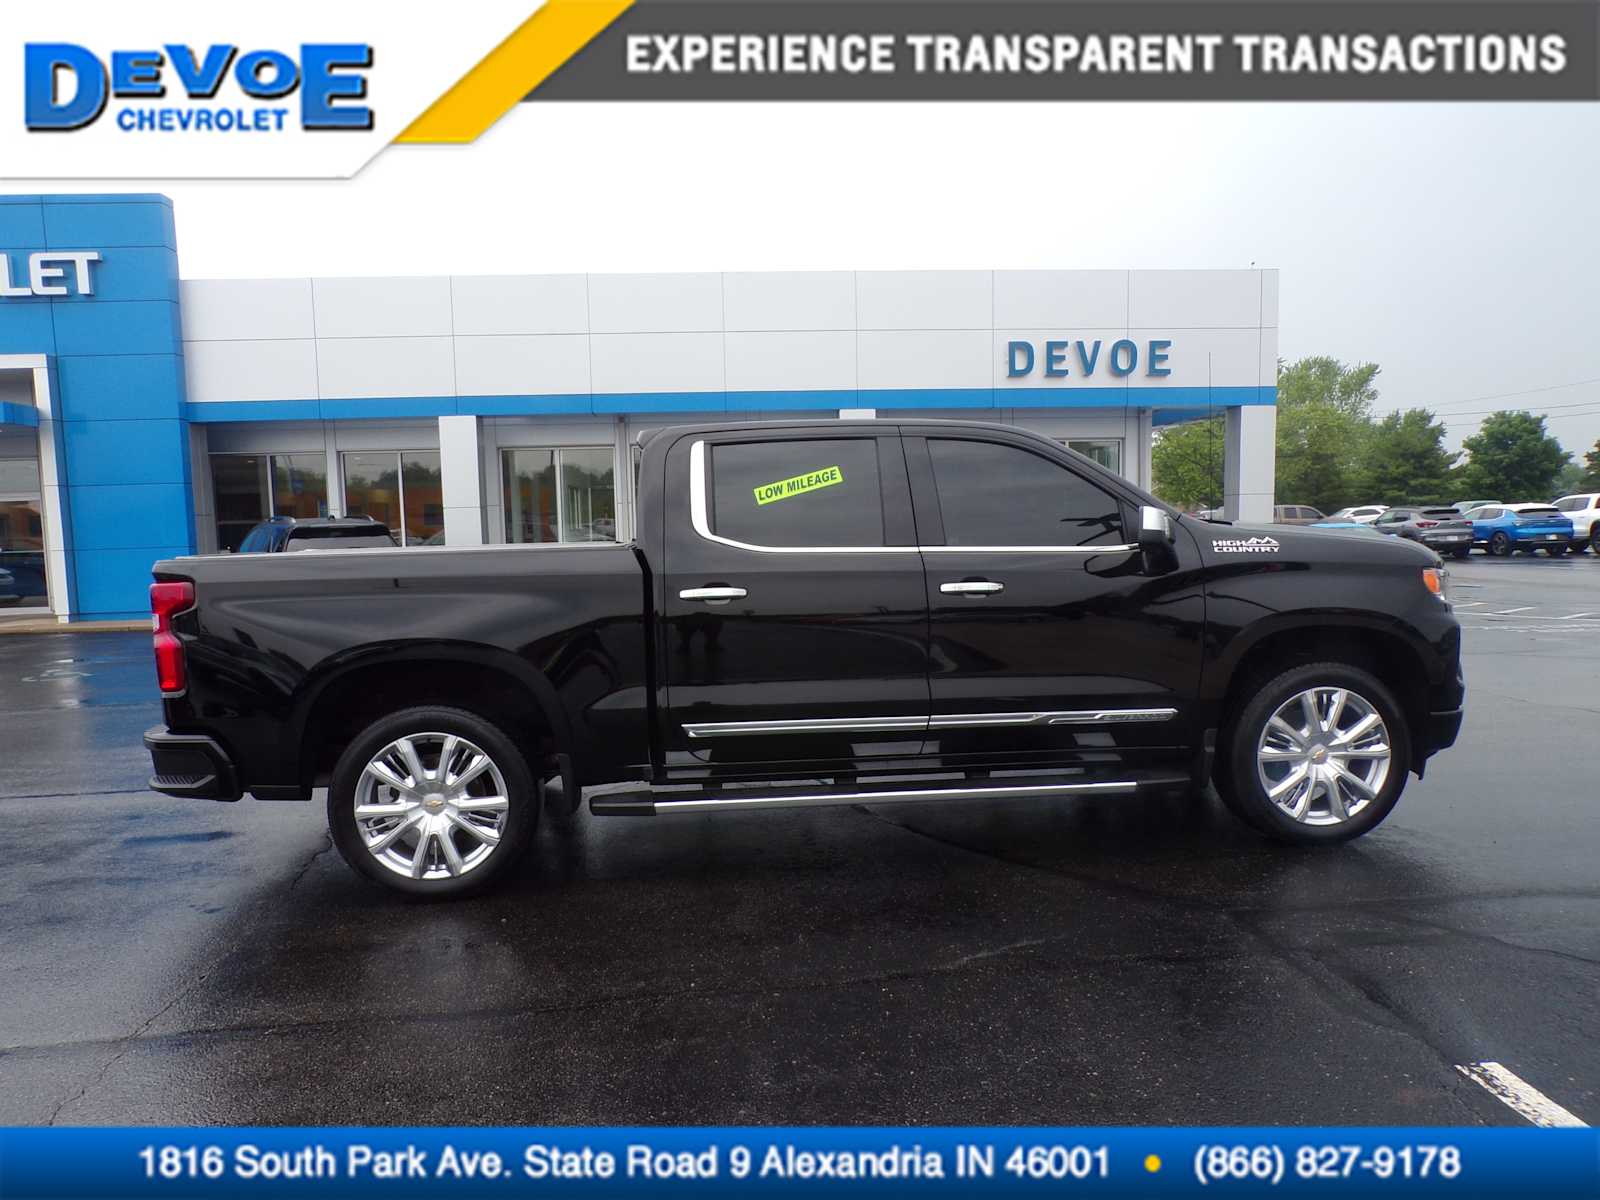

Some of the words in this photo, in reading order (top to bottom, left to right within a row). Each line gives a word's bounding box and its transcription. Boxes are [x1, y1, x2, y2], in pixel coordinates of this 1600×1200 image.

[1007, 339, 1172, 377] DEVOE
[758, 484, 784, 501] LOW
[786, 468, 838, 494] MILEAGE
